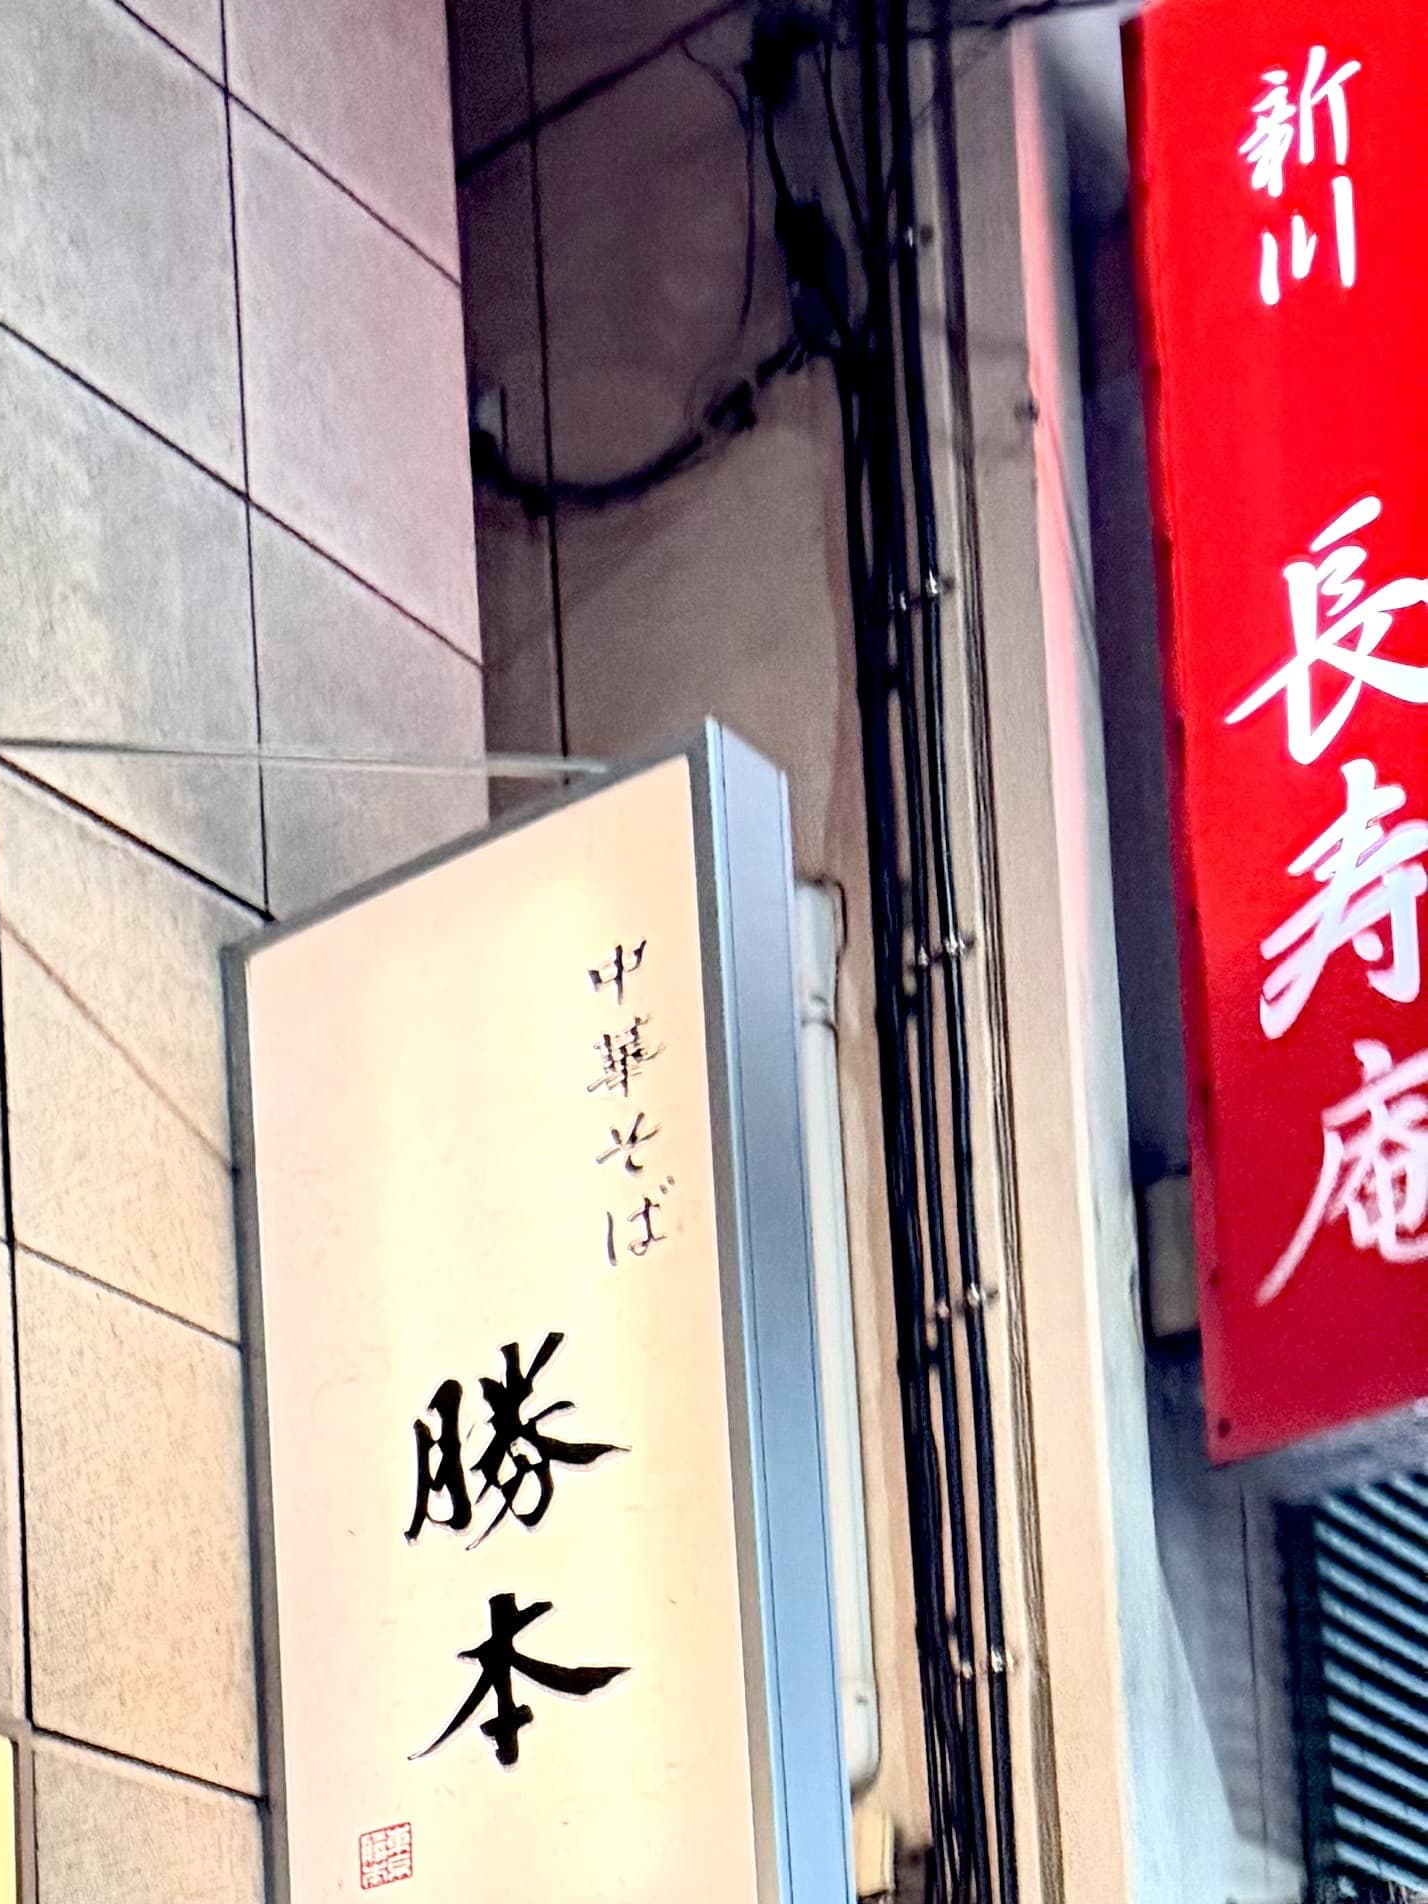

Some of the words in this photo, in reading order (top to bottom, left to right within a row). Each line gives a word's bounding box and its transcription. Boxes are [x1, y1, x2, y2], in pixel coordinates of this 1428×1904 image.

[1237, 44, 1361, 306] 新川
[1225, 494, 1428, 1307] 長寿庵
[587, 938, 676, 1268] 中華そば
[404, 1331, 632, 1768] 勝本
